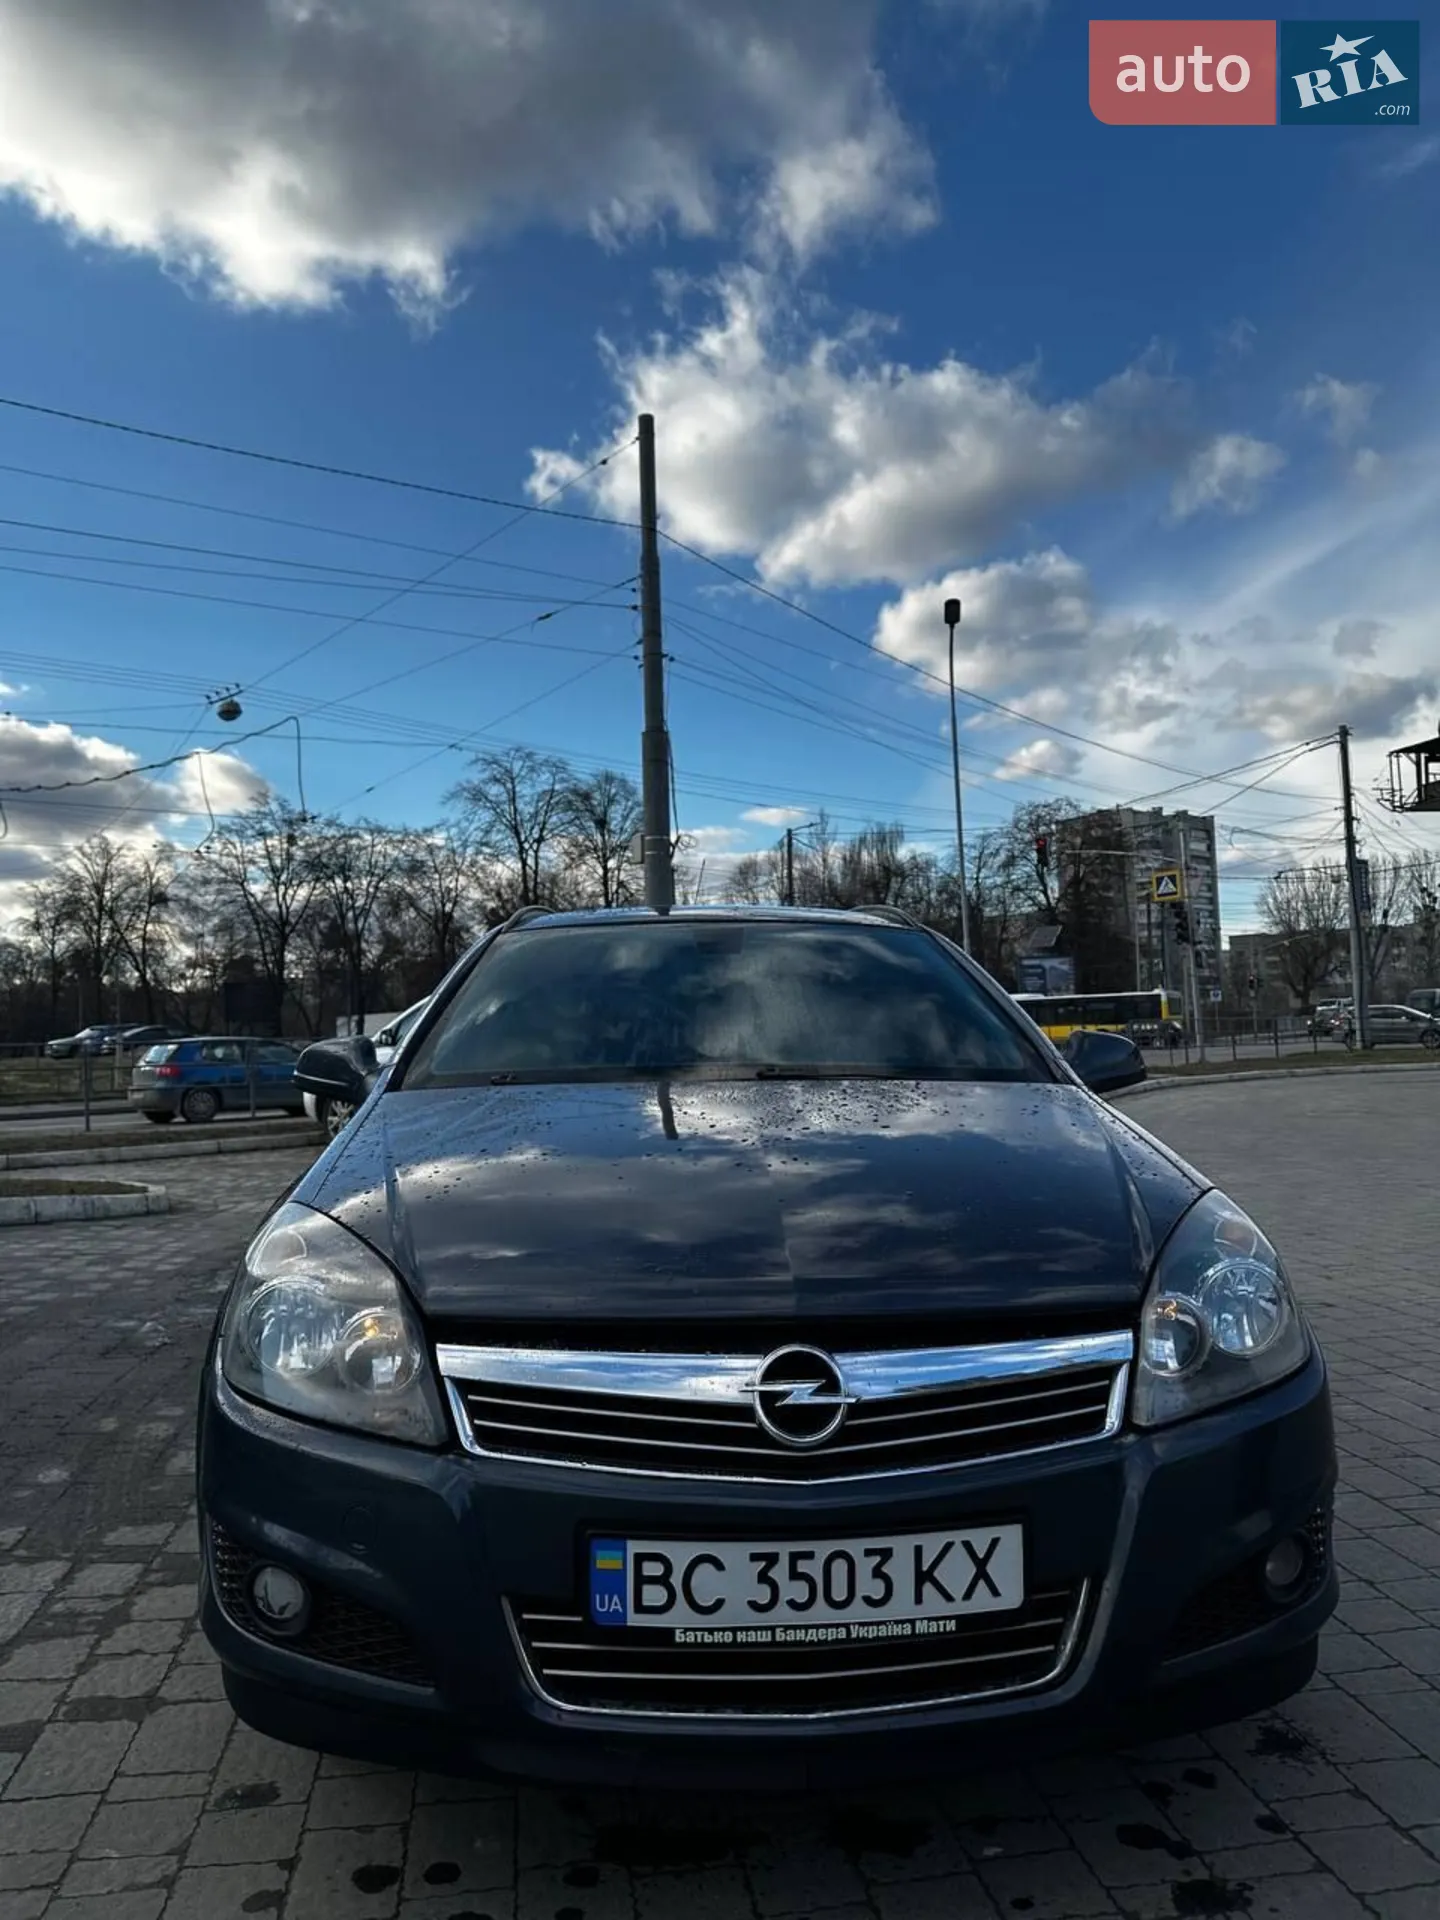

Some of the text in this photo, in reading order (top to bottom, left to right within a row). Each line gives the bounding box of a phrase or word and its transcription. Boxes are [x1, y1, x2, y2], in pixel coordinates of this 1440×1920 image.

[632, 1536, 1002, 1616] BC 3503 KX
[595, 1593, 623, 1613] UA
[674, 1618, 957, 1643] Батько наш Бандера Україна Мати
